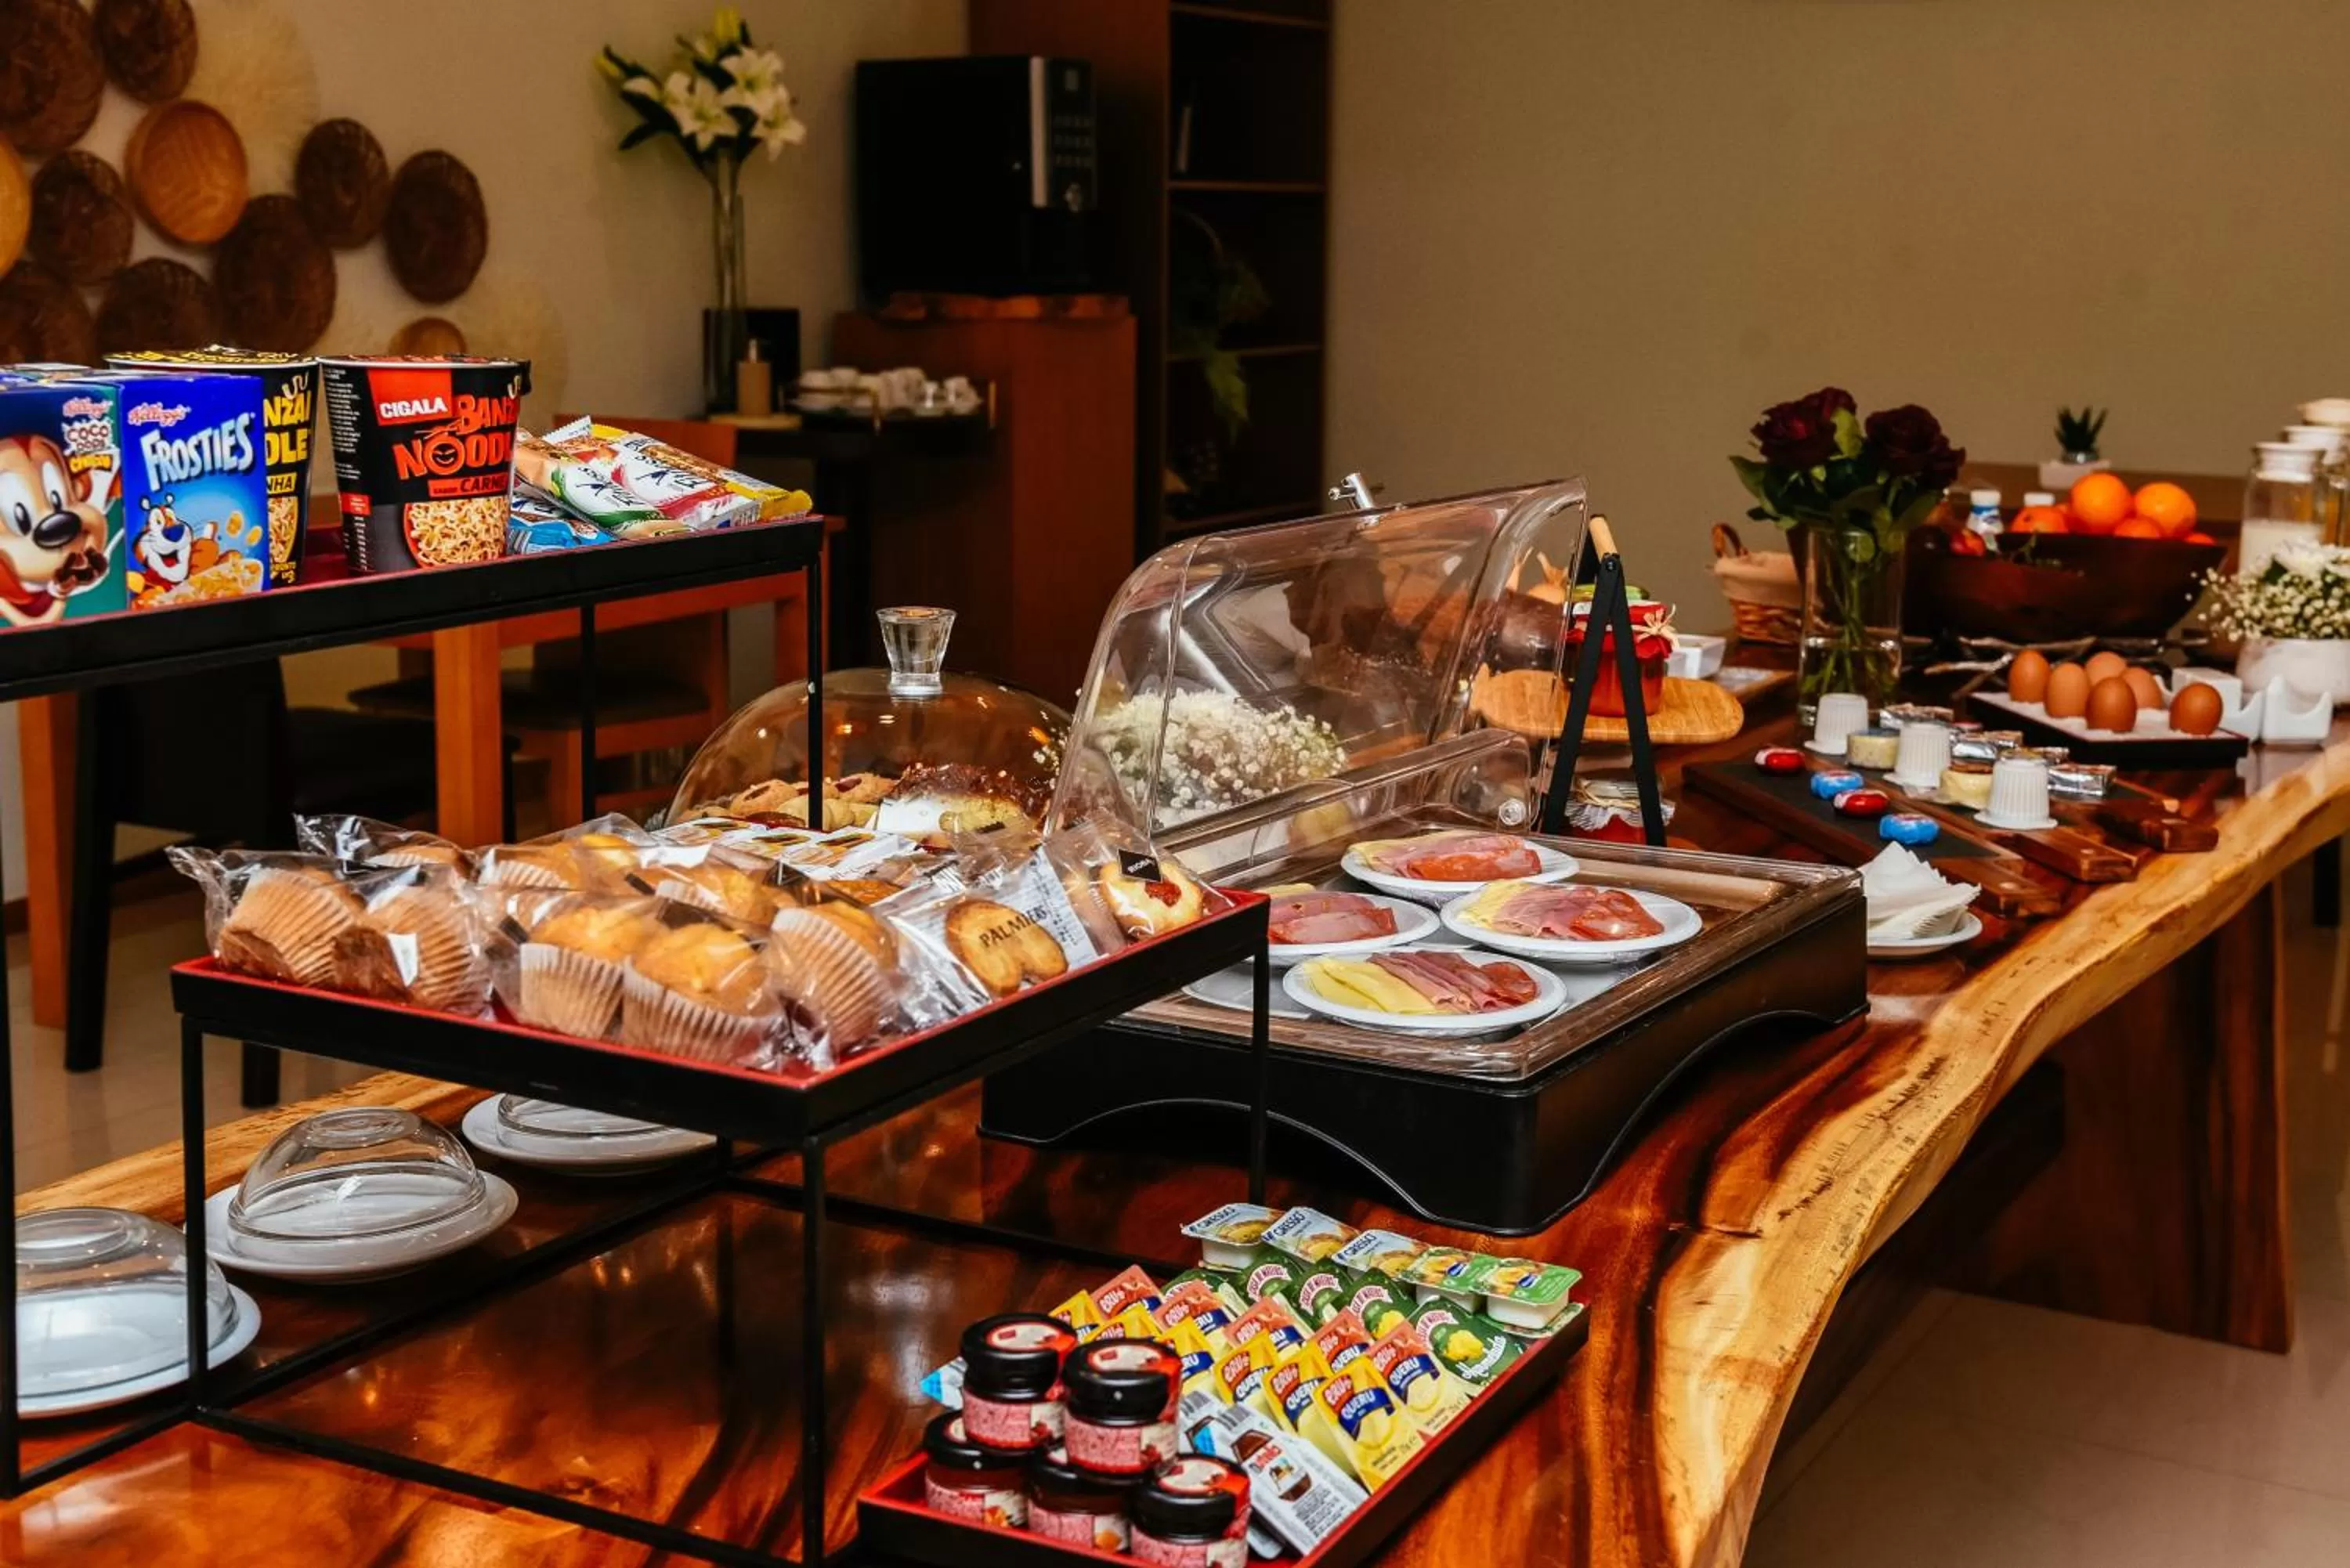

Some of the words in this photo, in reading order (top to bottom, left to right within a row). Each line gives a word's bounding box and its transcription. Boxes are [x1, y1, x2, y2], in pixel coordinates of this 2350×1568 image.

[263, 390, 312, 427] NZAI
[380, 397, 447, 418] CIGALA
[456, 395, 517, 435] BANZ
[67, 424, 109, 442] COCO
[264, 428, 308, 466] DLE
[140, 413, 253, 492] FROSTIES
[392, 432, 514, 480] NOODL
